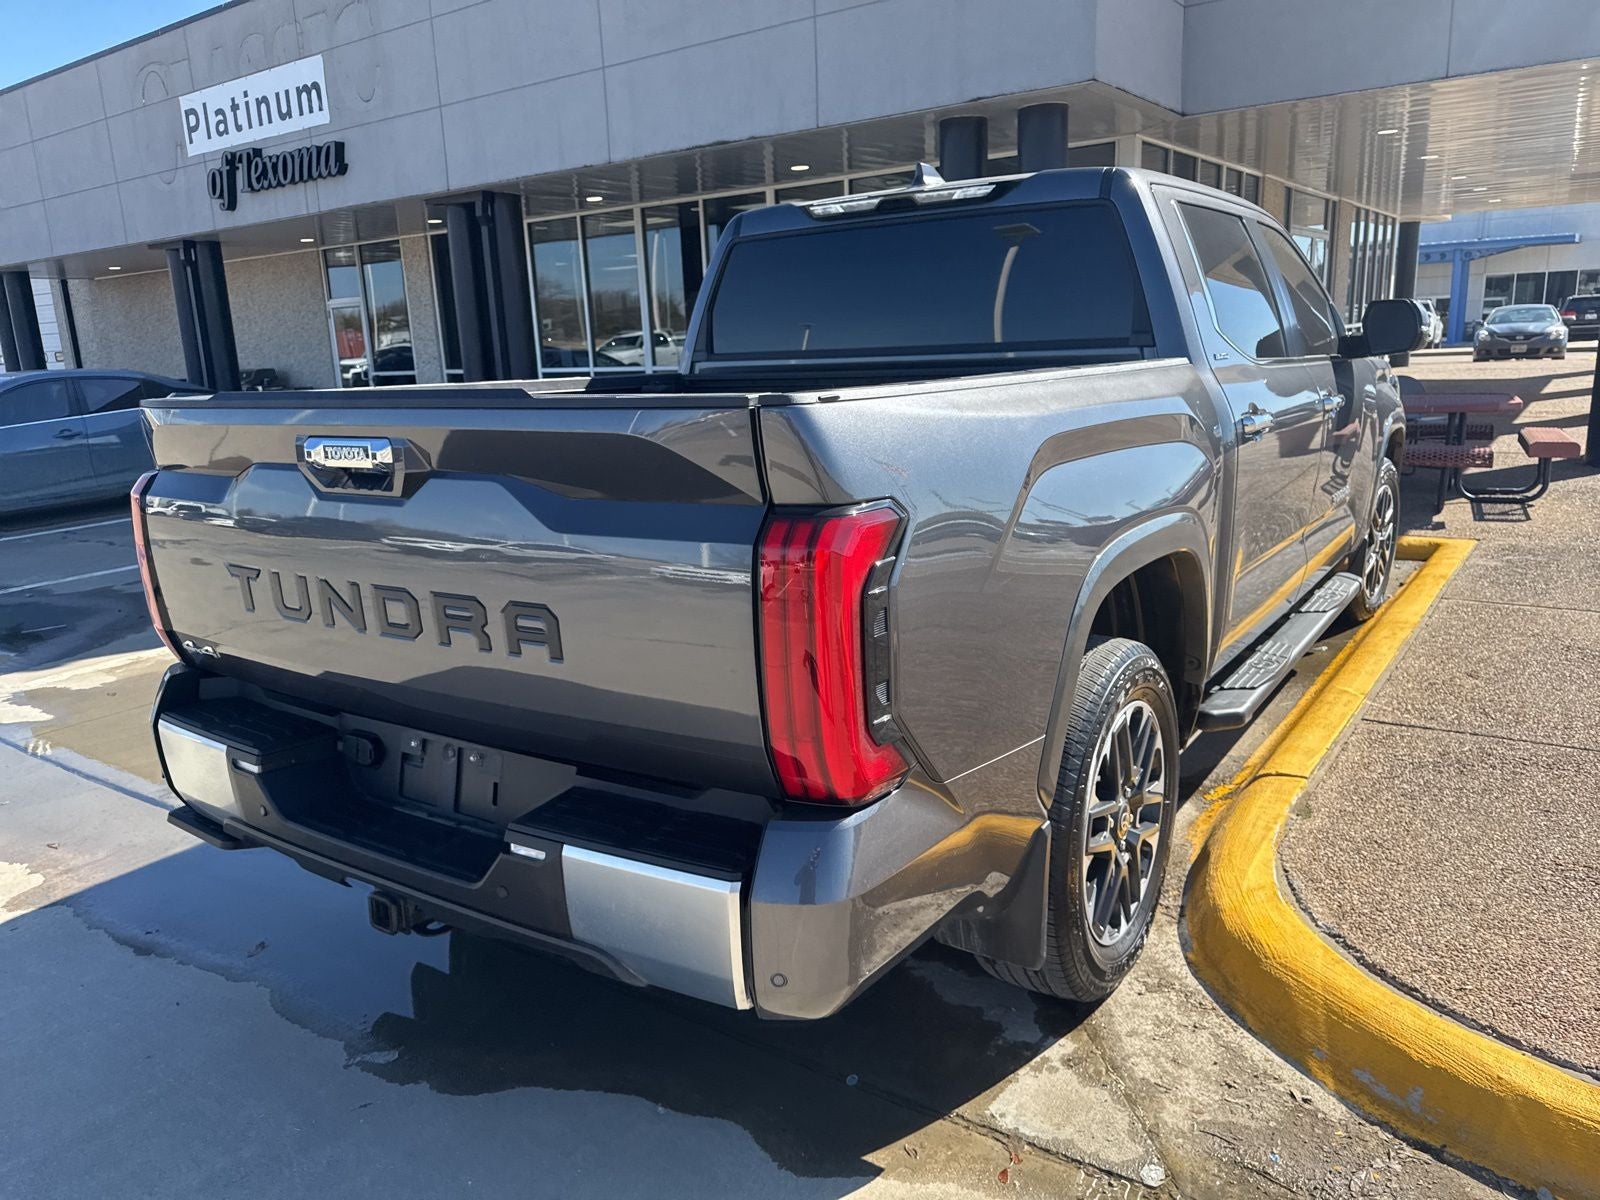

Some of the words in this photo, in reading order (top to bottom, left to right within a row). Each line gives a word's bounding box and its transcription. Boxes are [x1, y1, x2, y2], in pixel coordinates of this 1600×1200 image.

[184, 80, 324, 144] Platinum
[207, 151, 235, 211] of
[237, 141, 347, 193] Texoma
[325, 446, 367, 461] TOYOTA
[224, 562, 564, 664] TUNDRA
